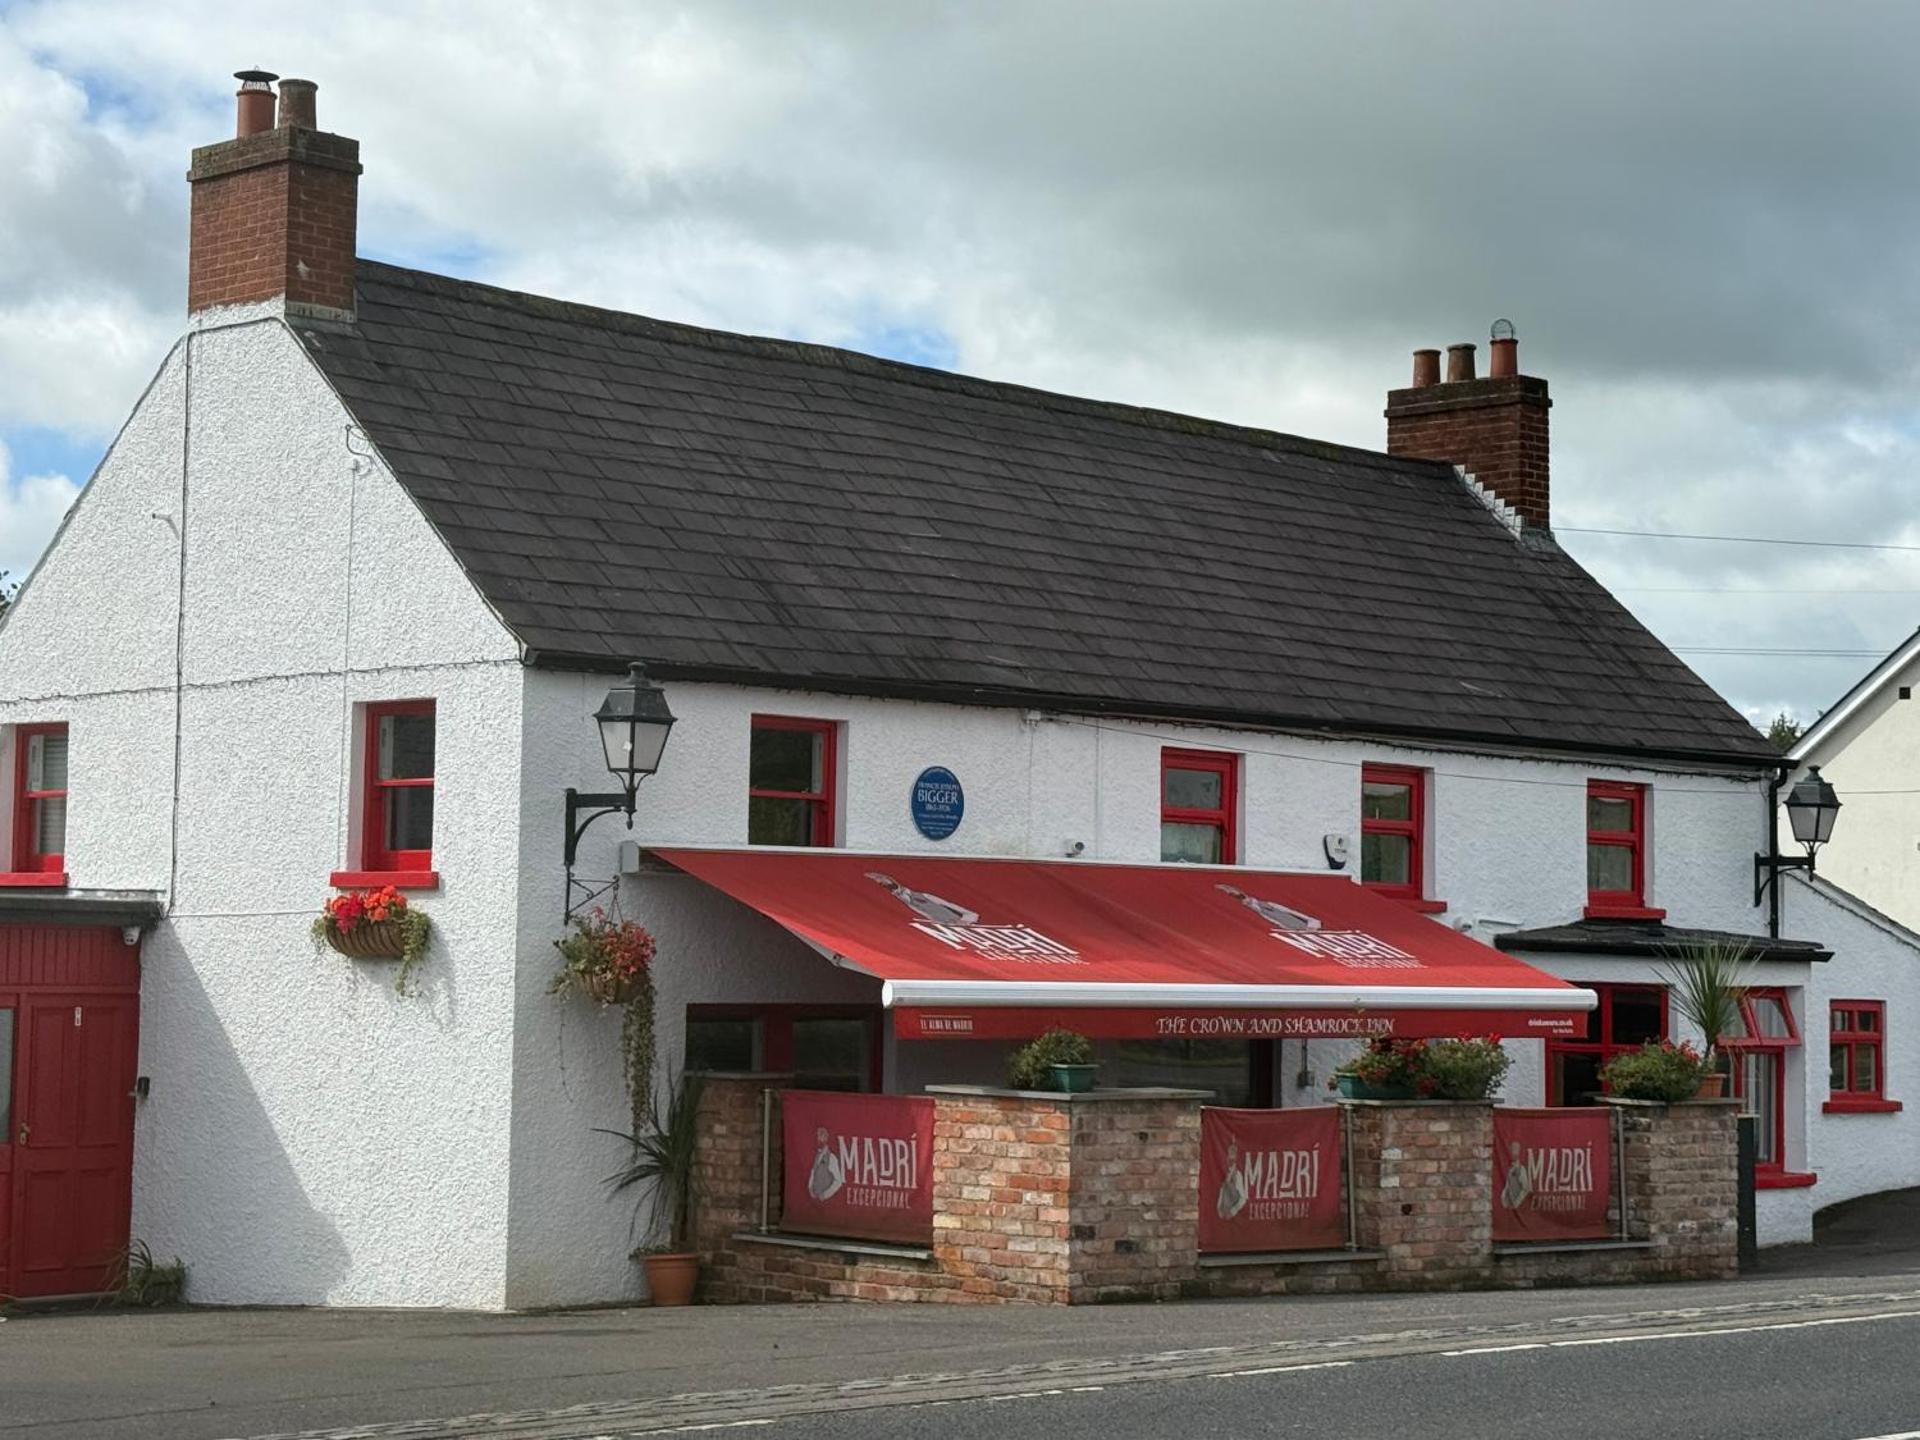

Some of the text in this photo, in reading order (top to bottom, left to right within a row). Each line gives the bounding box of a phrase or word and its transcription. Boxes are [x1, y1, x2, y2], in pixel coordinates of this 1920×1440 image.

[918, 789, 959, 805] BIGGER
[1156, 1016, 1395, 1034] THE CROWN AND SHAMROCK INN
[838, 1132, 918, 1189] MADRÍ
[1244, 1142, 1320, 1199] MADRÍ
[1527, 1141, 1593, 1192] MADRÍ
[846, 1187, 911, 1209] EXCEPCIONAL
